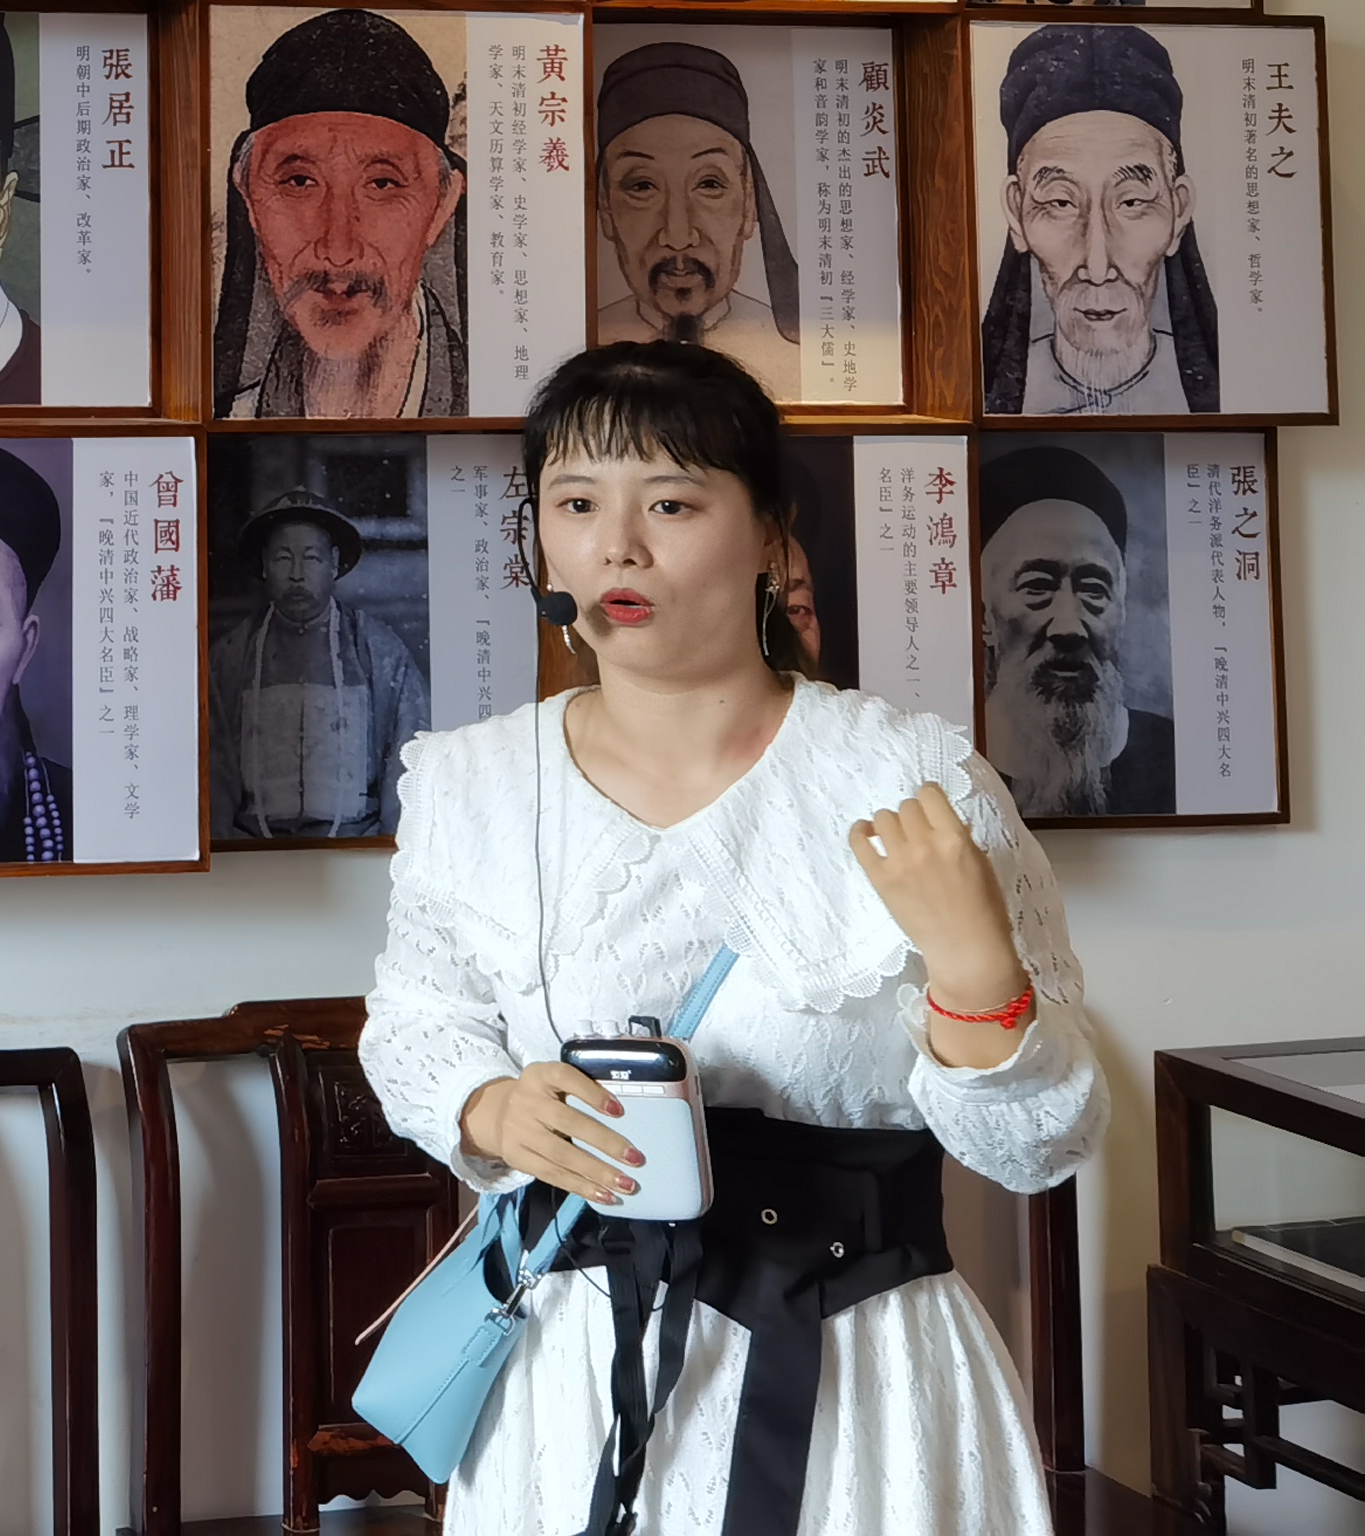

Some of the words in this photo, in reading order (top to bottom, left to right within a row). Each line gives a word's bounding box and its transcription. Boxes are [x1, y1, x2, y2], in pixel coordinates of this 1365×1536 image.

[101, 48, 135, 170] 張居正
[858, 62, 891, 180] 顧炎武
[1265, 62, 1297, 179] 王夫之
[149, 471, 184, 603] 曾國藩
[450, 466, 466, 493] 之一
[499, 466, 531, 591] 左宗棠
[924, 466, 958, 595] 李鴻章
[1230, 465, 1261, 581] 張之洞
